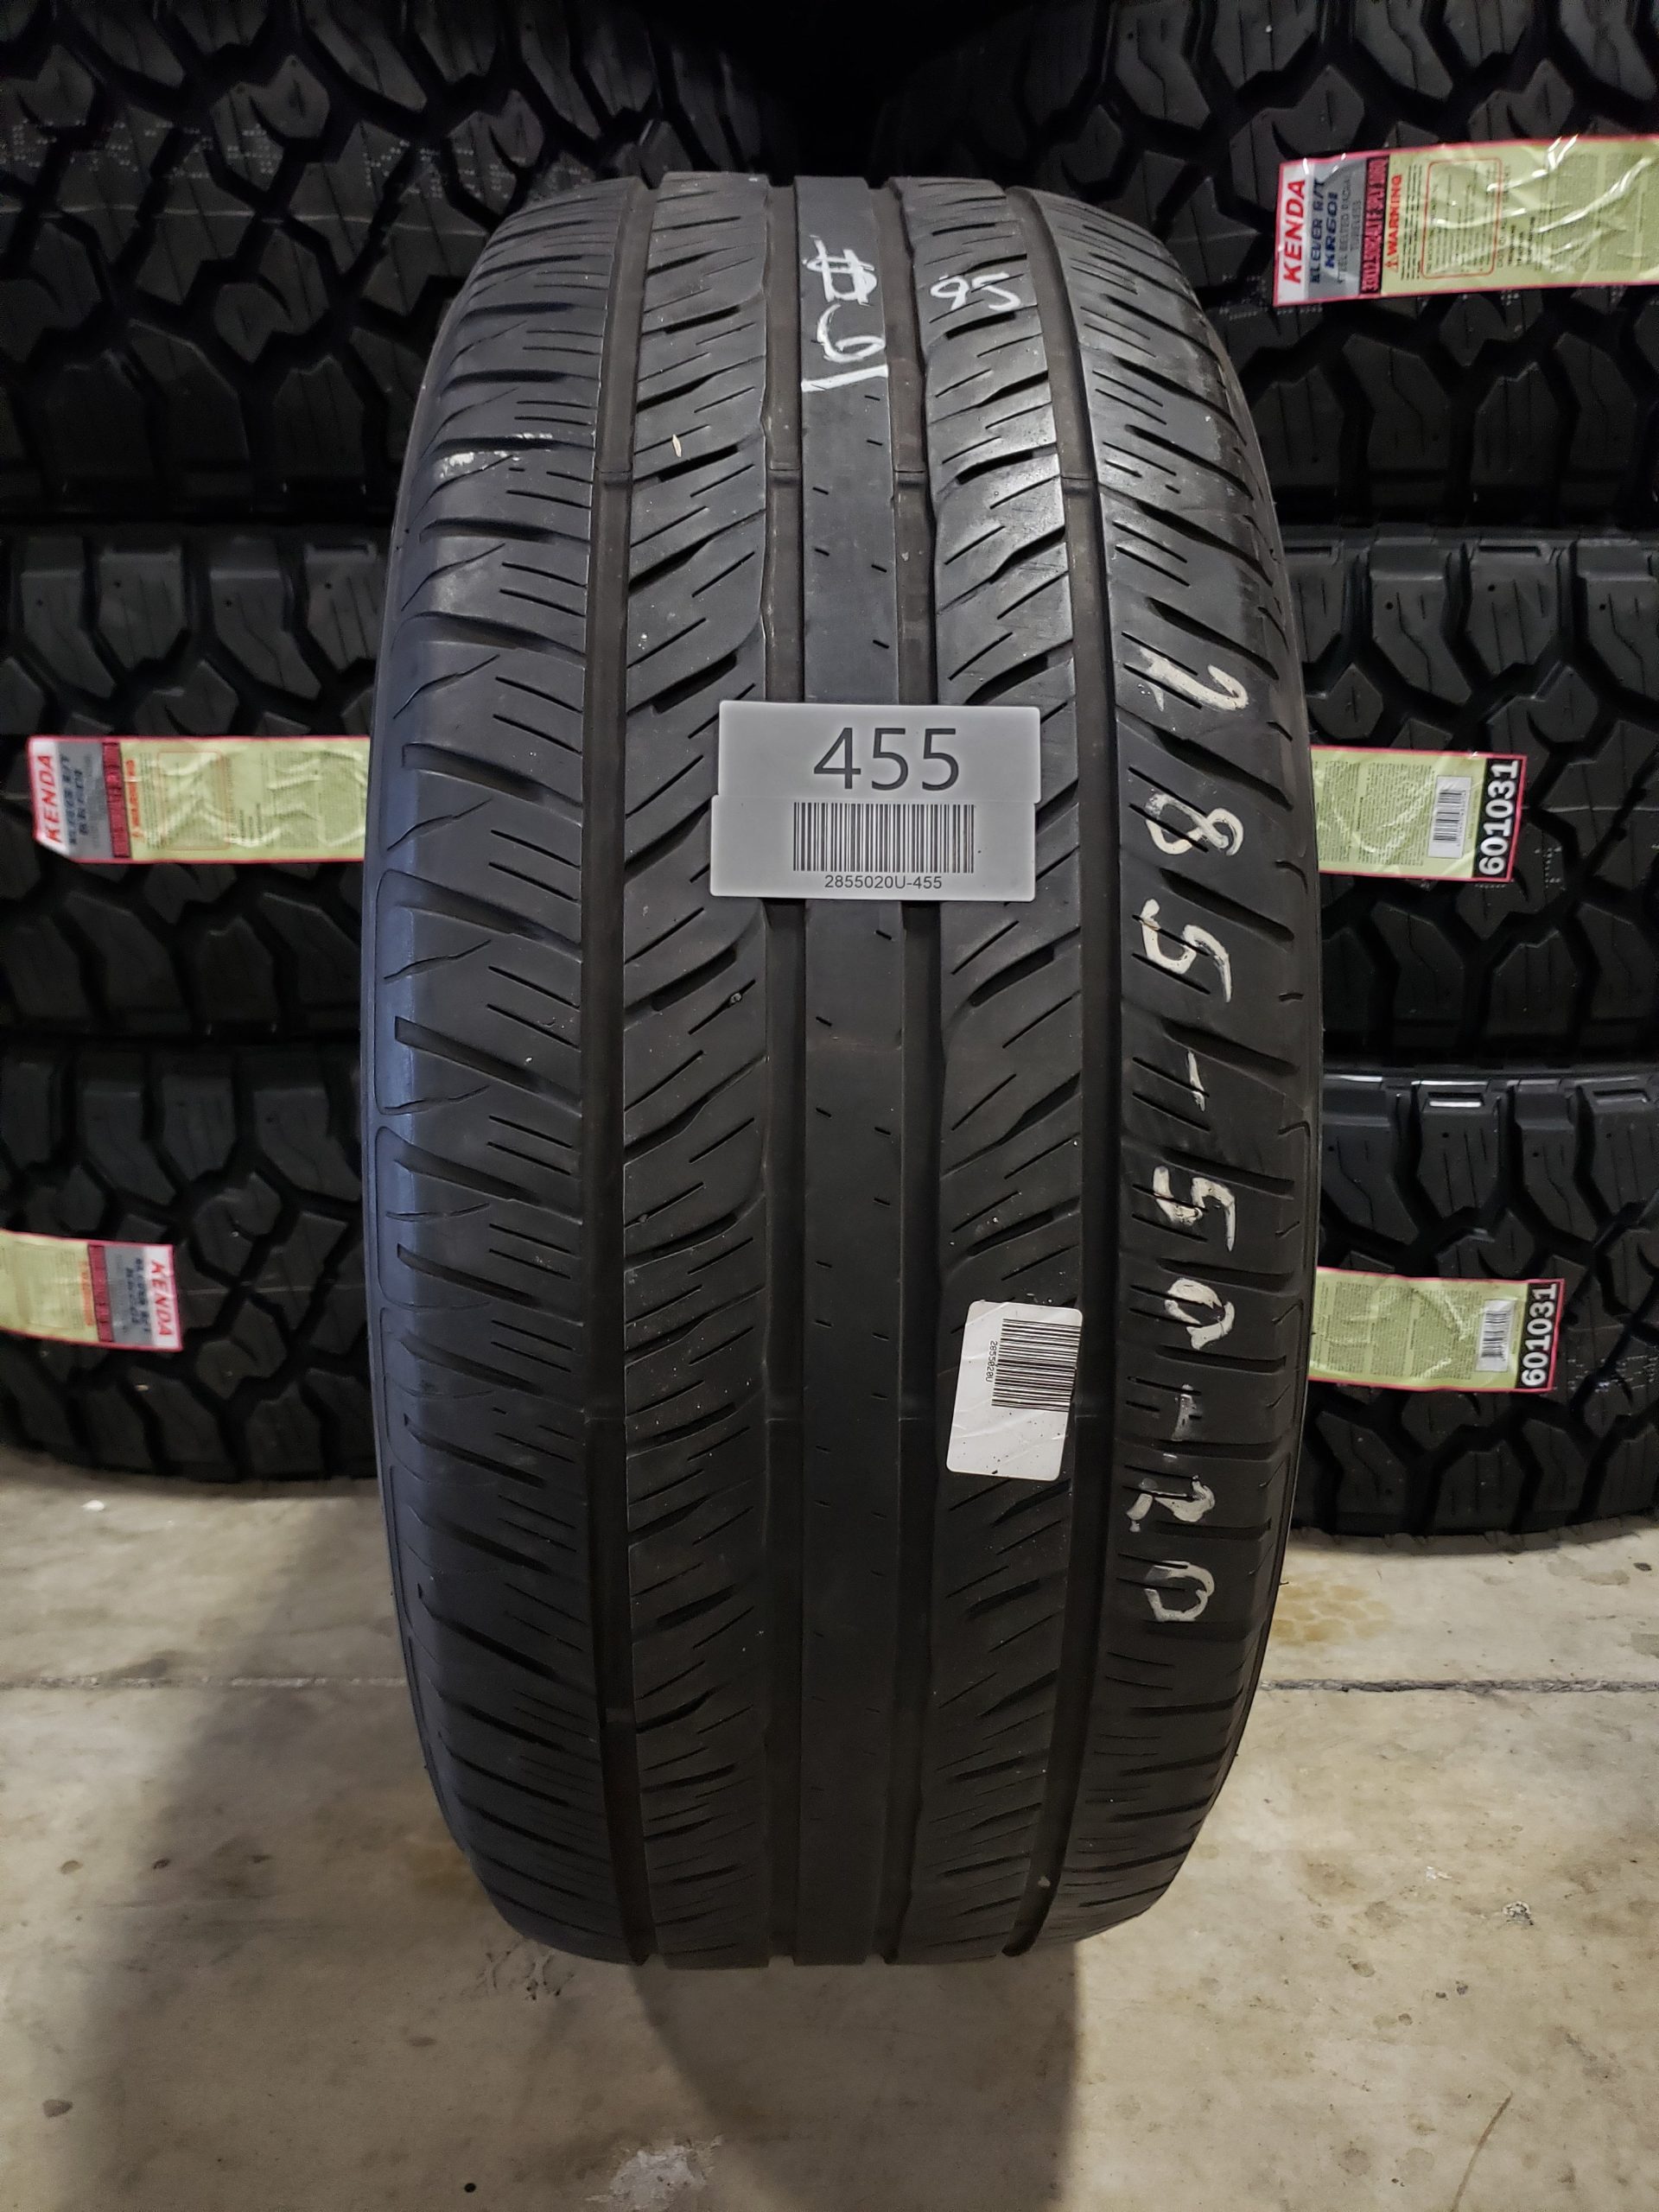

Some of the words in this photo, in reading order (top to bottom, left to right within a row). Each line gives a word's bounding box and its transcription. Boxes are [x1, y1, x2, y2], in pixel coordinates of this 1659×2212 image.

[1282, 179, 1306, 283] KENDA
[1387, 175, 1402, 257] WARNING
[37, 753, 62, 843] KENDA
[814, 727, 960, 791] 455
[1478, 760, 1519, 876] 601031
[823, 874, 943, 890] 2855020U-455
[150, 1259, 173, 1336] KENDA
[1521, 1283, 1557, 1388] 601031
[985, 1340, 998, 1382] 2855020U
